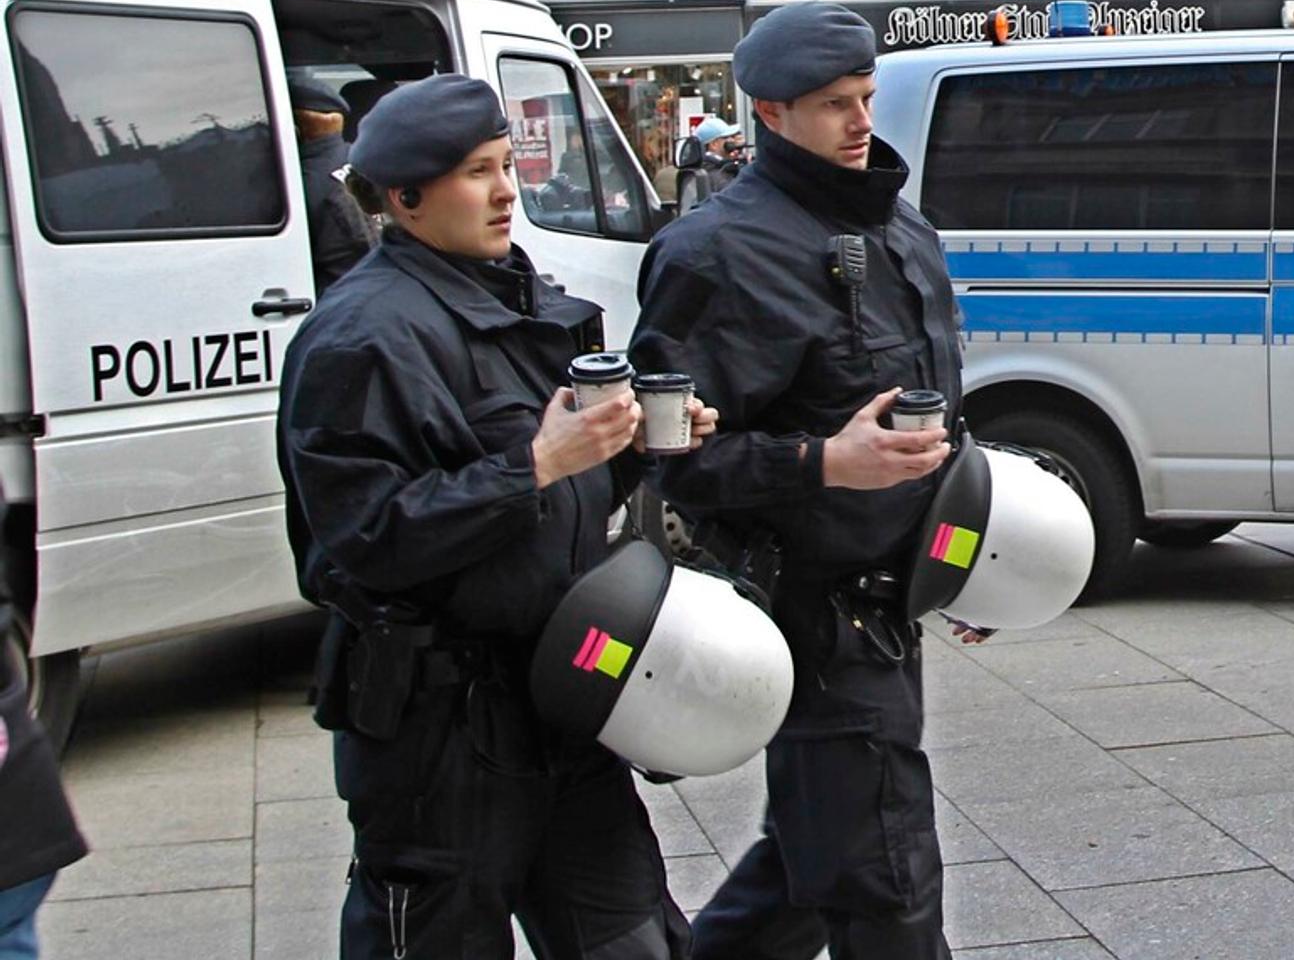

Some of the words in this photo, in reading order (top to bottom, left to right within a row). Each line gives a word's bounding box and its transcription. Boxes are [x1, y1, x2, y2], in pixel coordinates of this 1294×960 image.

[559, 23, 613, 50] OP
[884, 5, 990, 46] Kölner
[91, 330, 273, 402] POLIZEI
